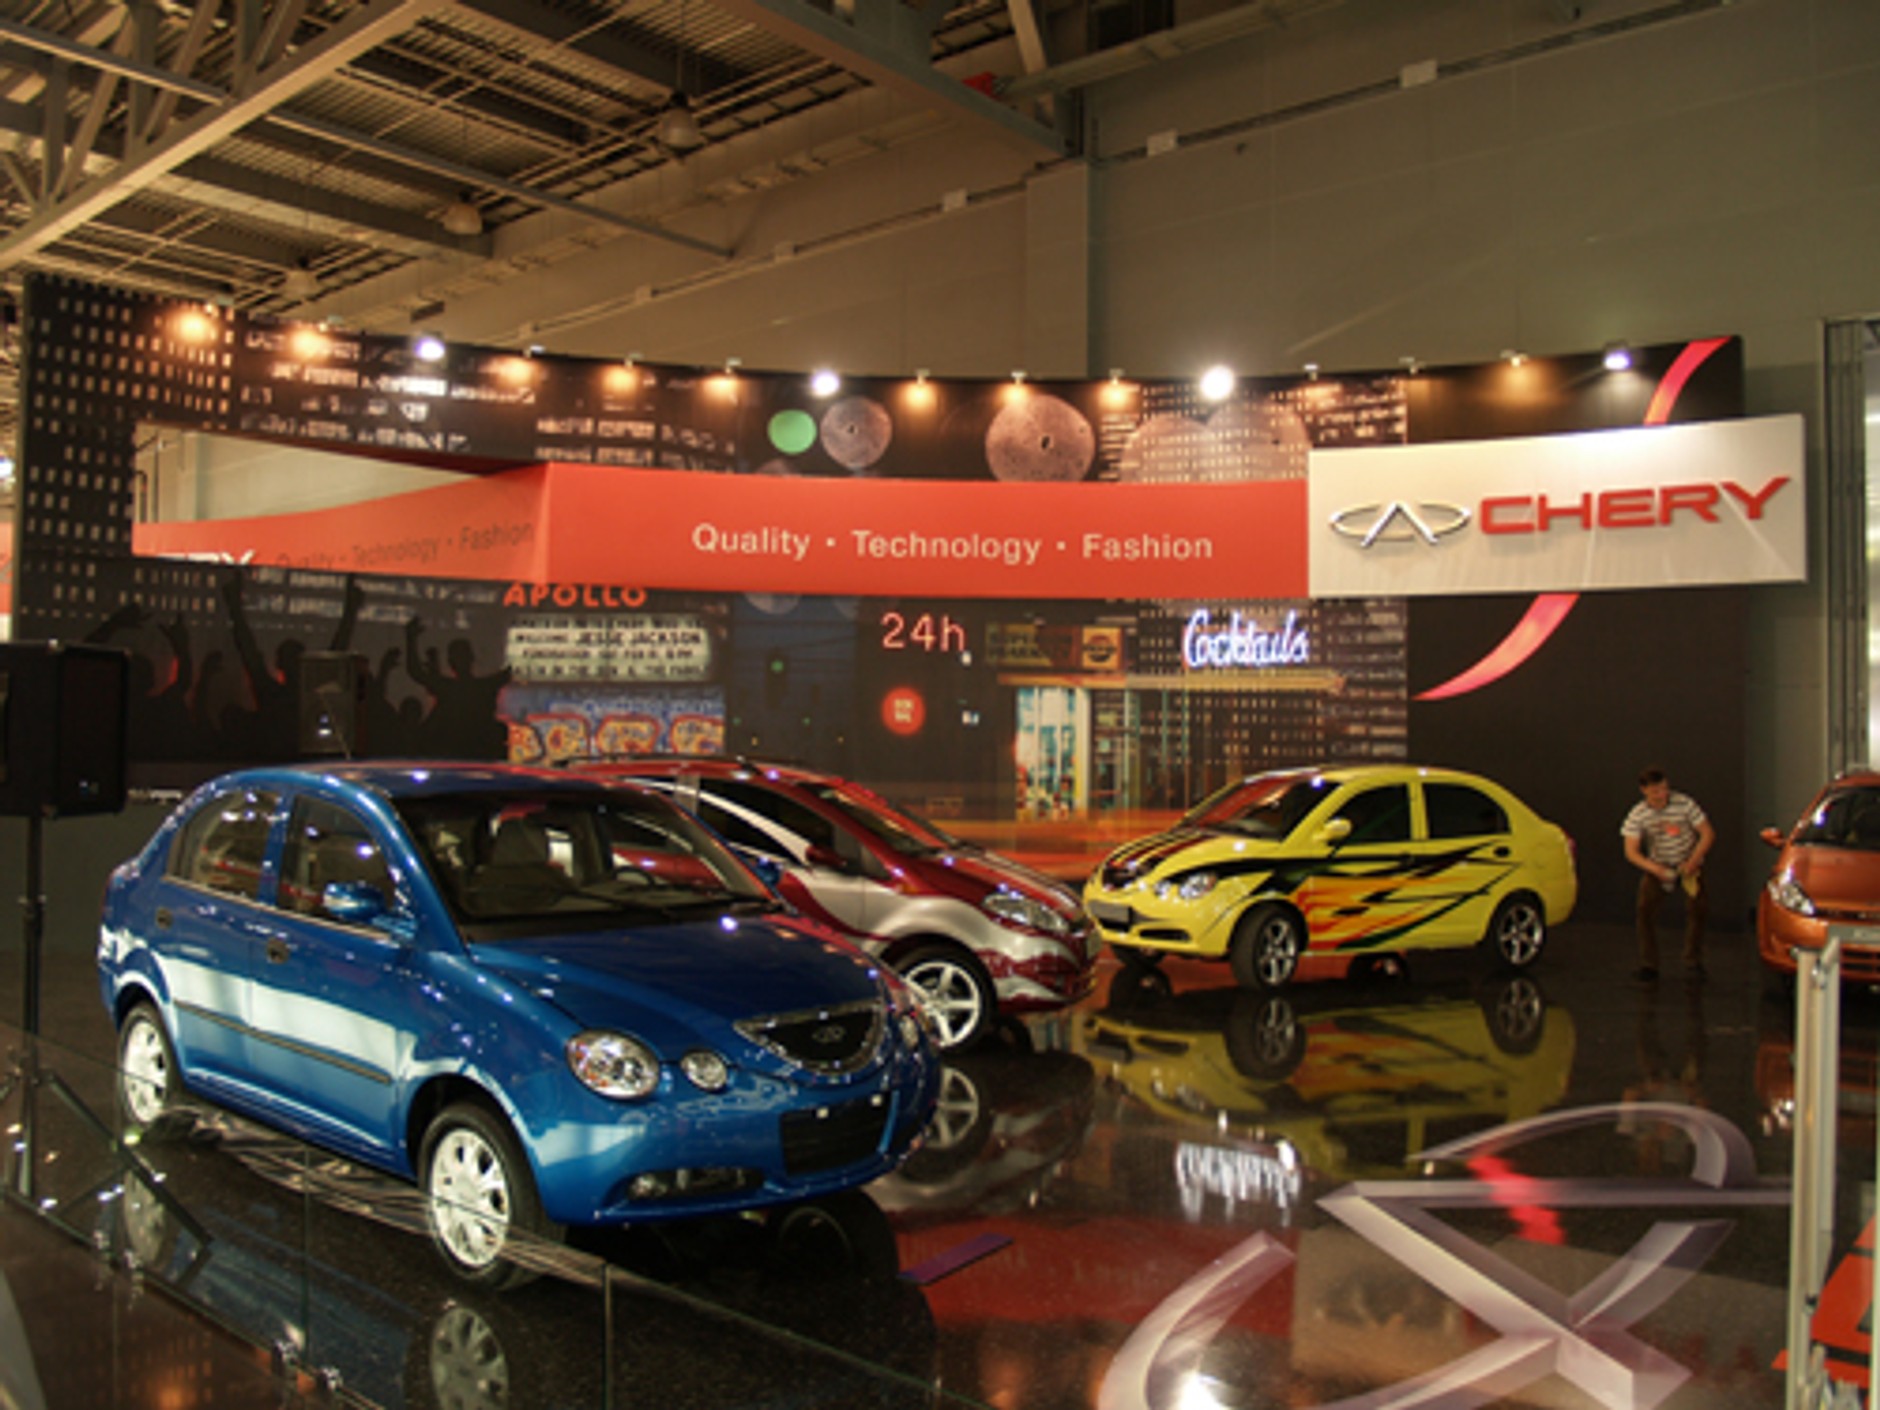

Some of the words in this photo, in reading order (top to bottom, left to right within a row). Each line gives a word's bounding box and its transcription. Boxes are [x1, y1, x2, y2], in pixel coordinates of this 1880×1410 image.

[1480, 475, 1791, 535] CHERY
[352, 533, 440, 566] Technology
[459, 522, 533, 552] Fashion
[691, 523, 811, 562] Quality
[851, 530, 1041, 565] Technology
[1082, 533, 1213, 560] Fashion
[503, 581, 648, 608] APOLLO
[880, 611, 966, 652] 24h
[1182, 608, 1310, 669] Cocktails
